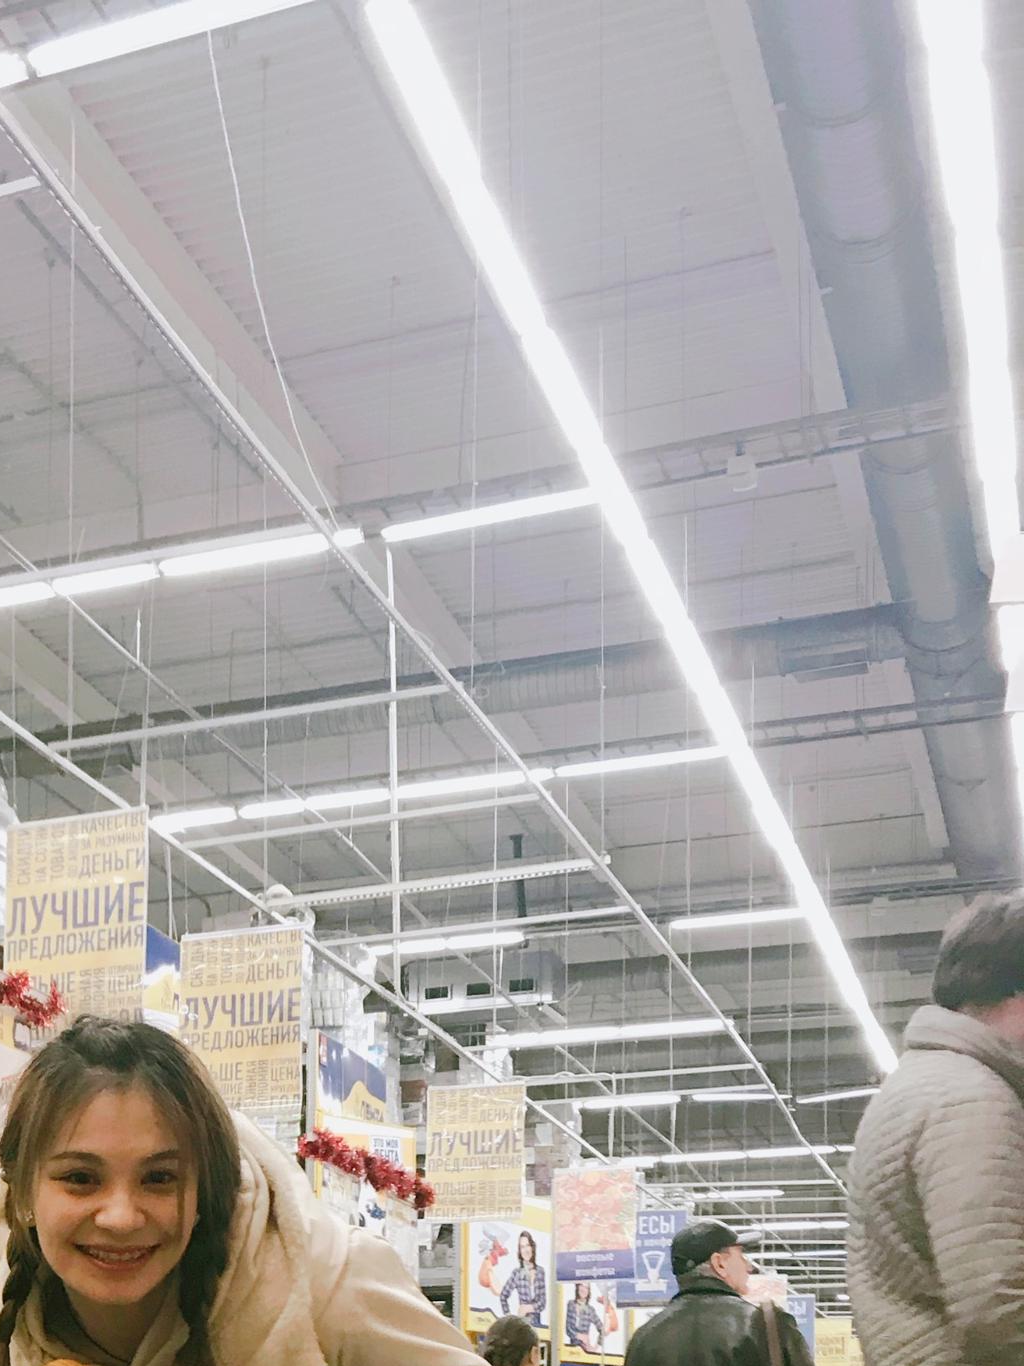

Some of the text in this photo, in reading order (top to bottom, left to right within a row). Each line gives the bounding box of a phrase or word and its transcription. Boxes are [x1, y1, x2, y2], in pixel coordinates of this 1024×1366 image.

[79, 847, 146, 879] ДЕНЬГИ
[6, 881, 145, 938] ЛУЧШИЕ
[6, 924, 144, 963] ПРЕДЛОЖЕНИЯ
[246, 960, 302, 985] ДЕНЬГИ
[179, 987, 301, 1031] ЛУЧШИЕ
[180, 1023, 301, 1053] ПРЕДЛОЖЕНИЯ
[428, 1127, 522, 1157] ЛУЧШИЕ
[427, 1154, 523, 1173] ПРЕДЛОЖЕНИЯ
[637, 1214, 676, 1235] ЕСЫ
